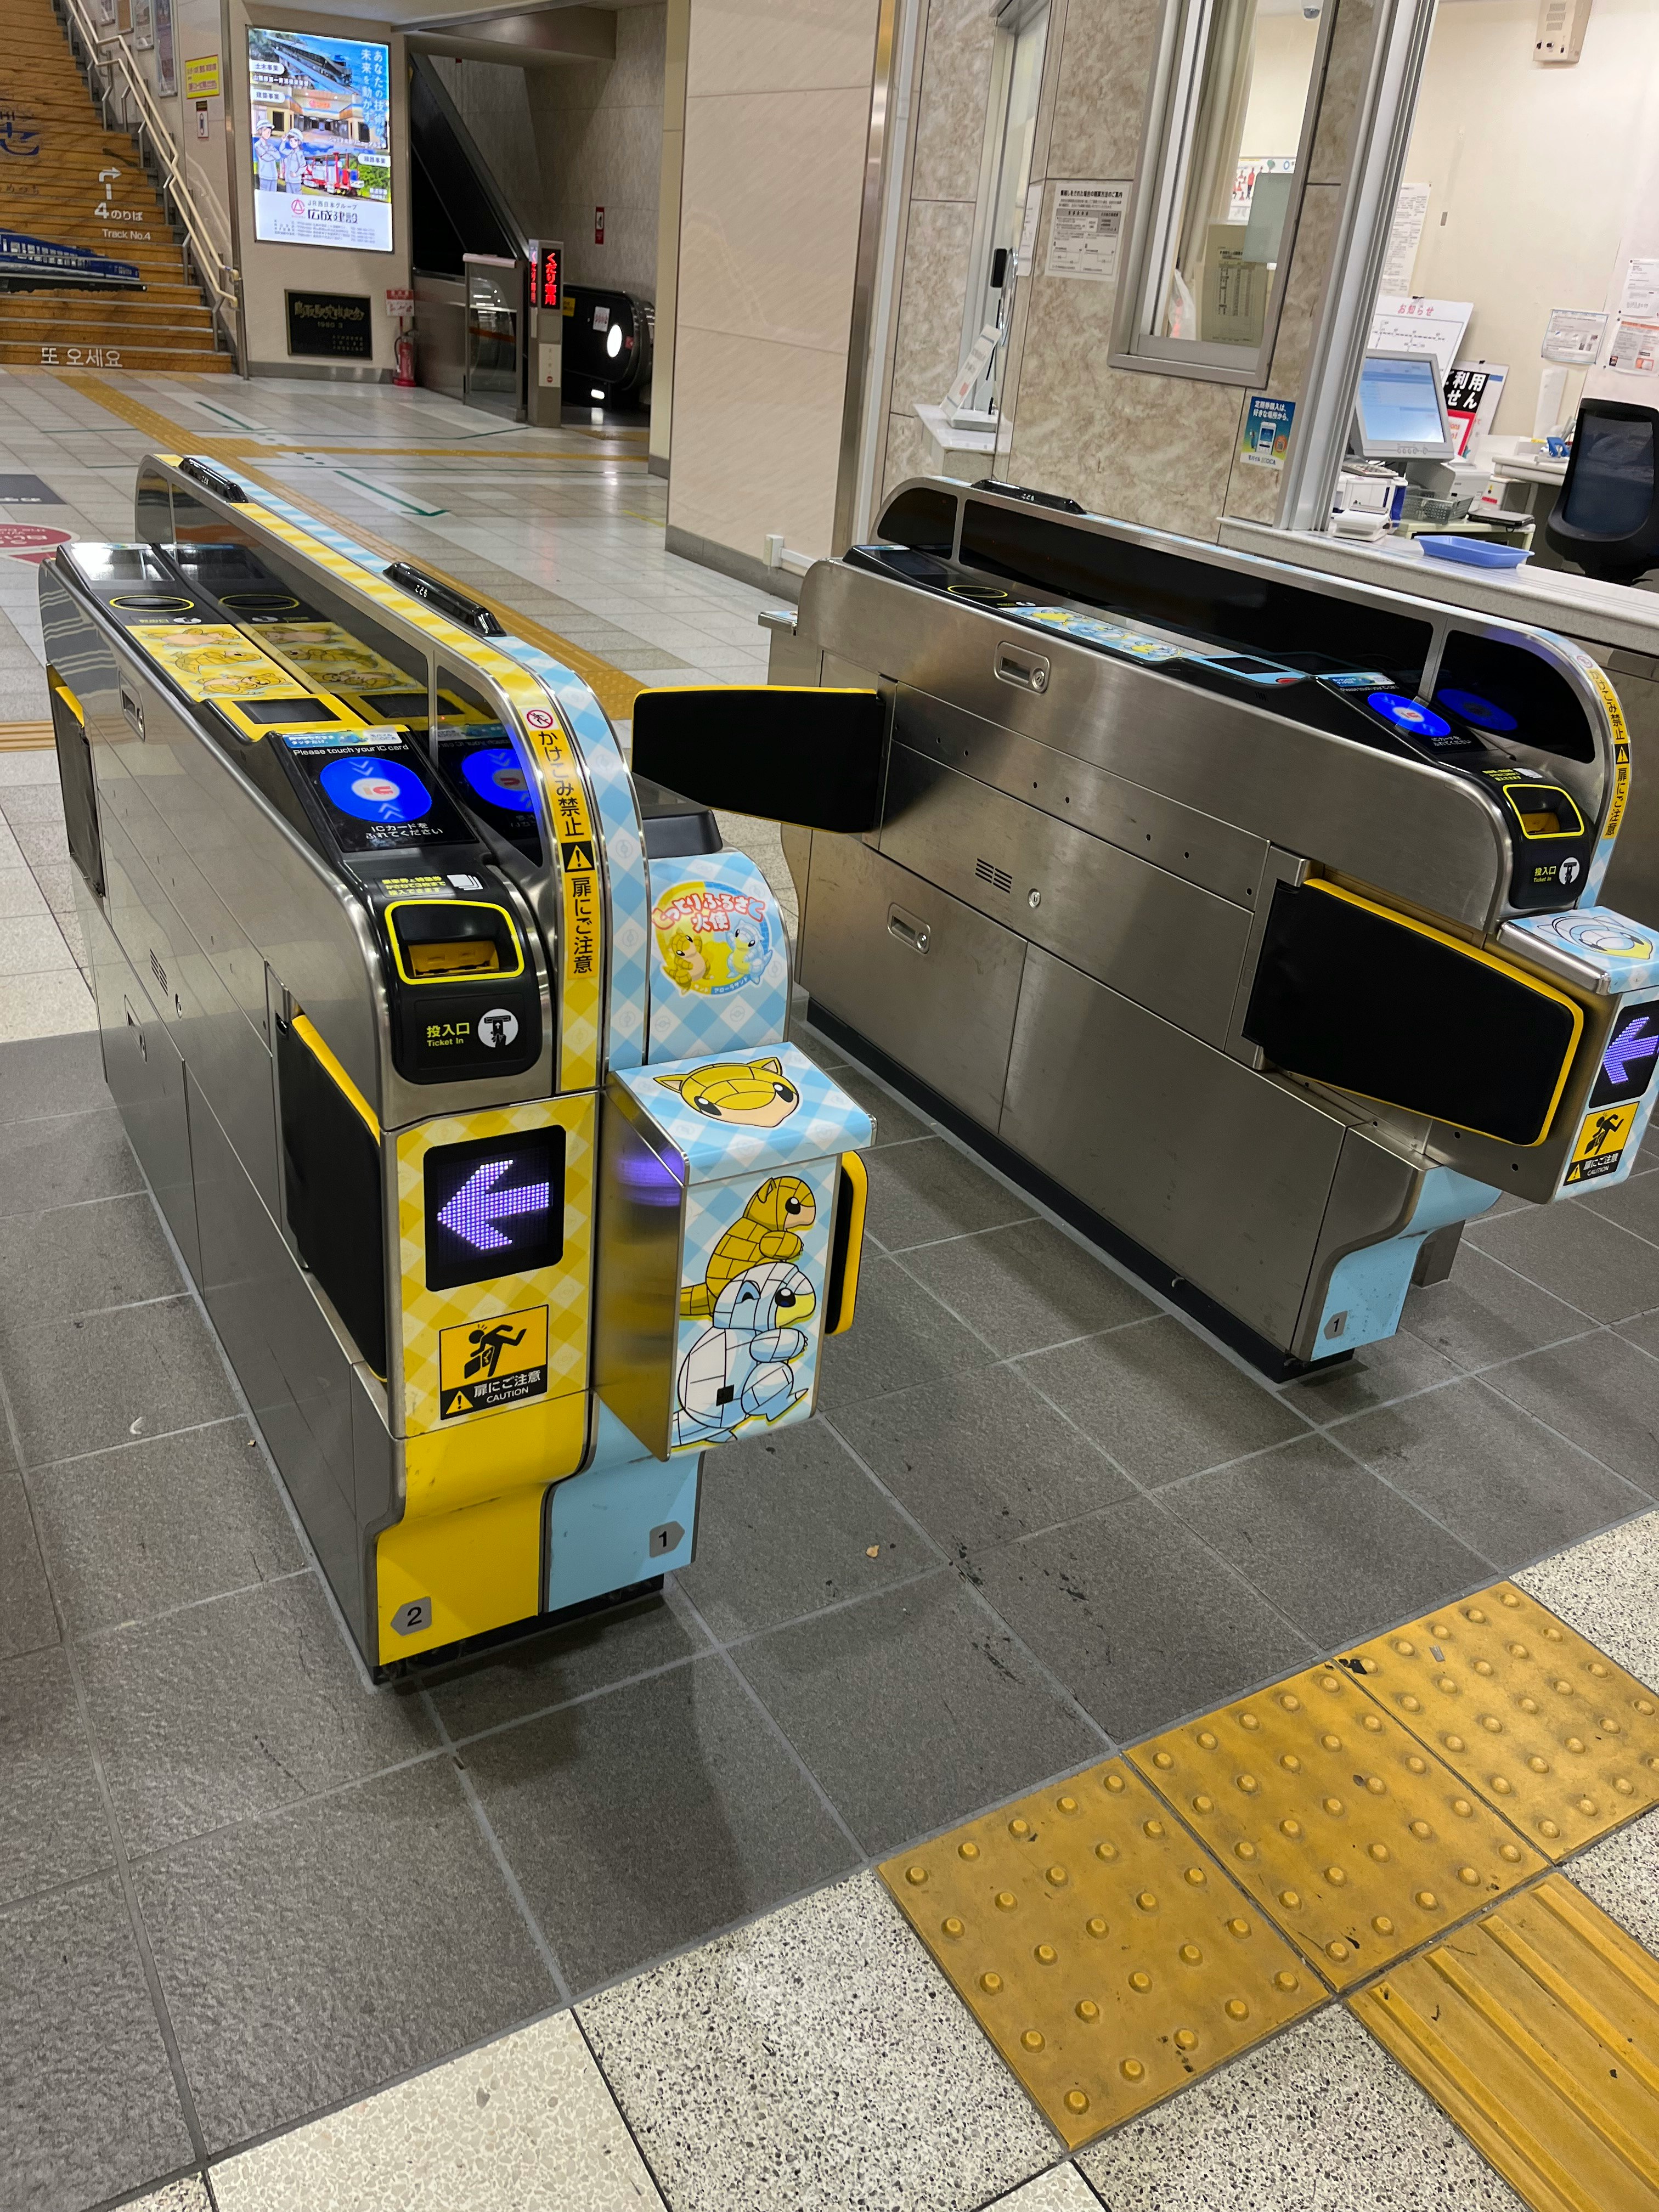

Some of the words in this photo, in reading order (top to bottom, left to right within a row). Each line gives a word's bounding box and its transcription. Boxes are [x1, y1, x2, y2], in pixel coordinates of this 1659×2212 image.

[255, 63, 279, 71] 土木事業
[362, 49, 374, 129] 未来を動かす。
[308, 200, 358, 210] JR西日本グループ
[308, 208, 358, 224] 広成建設
[101, 228, 128, 239] Track
[130, 230, 151, 240] No.4
[1397, 303, 1435, 317] お知らせ
[41, 347, 59, 364] 또
[66, 348, 123, 368] 오세요
[538, 731, 584, 837] かけこみ禁止
[365, 828, 443, 839] ふれてください
[371, 822, 429, 832] ICカードを
[1534, 866, 1556, 877] 投入口
[652, 893, 766, 930] とっとりふるさと
[571, 877, 593, 974] 扉にご注意
[691, 910, 730, 934] 大使
[426, 1022, 470, 1038] 投入口
[426, 1039, 453, 1047] Ticket
[1587, 1165, 1610, 1176] CAUTION
[1333, 1318, 1340, 1333] 1
[474, 1369, 541, 1398] 扉にご注意
[486, 1386, 529, 1403] CAUTION
[658, 1530, 668, 1548] 1
[407, 1606, 422, 1627] 2
